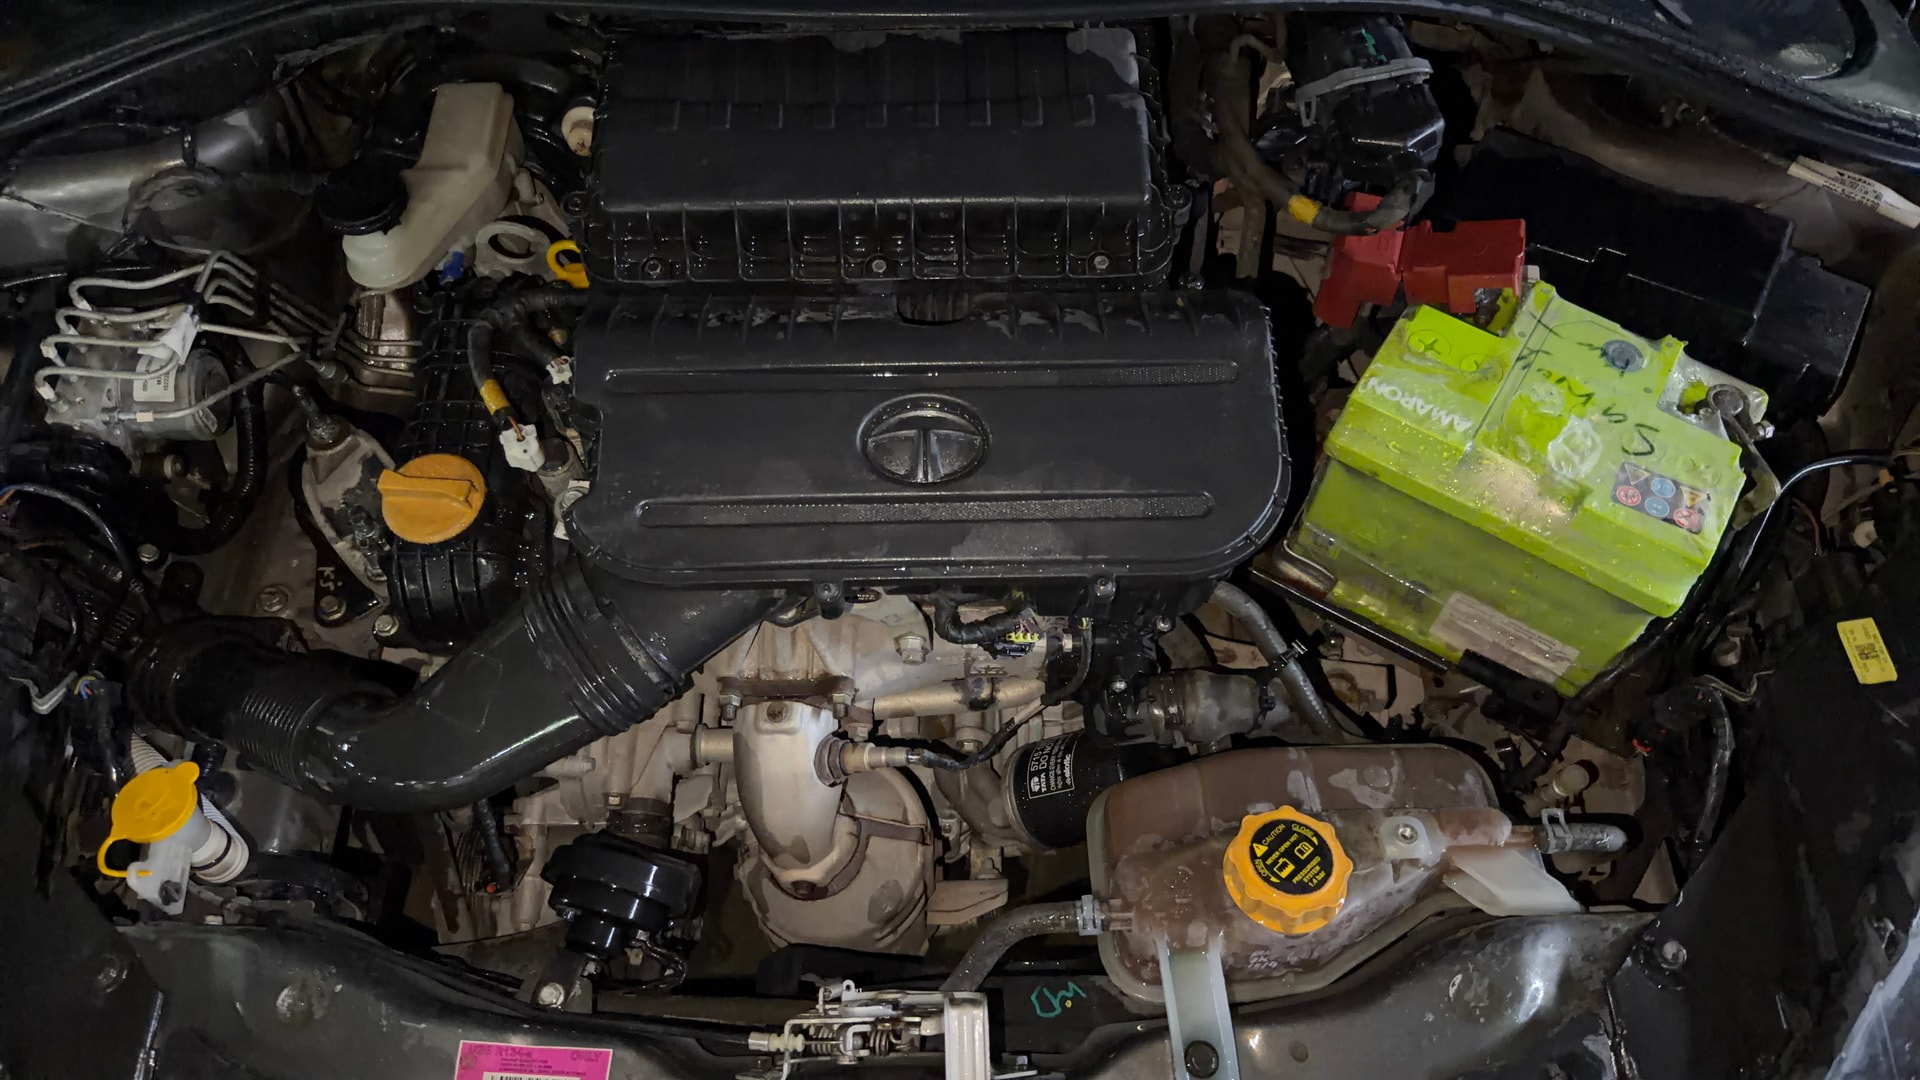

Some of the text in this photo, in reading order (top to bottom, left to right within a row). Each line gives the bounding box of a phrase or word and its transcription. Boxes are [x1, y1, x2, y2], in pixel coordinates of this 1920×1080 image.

[1366, 376, 1474, 433] AMARON
[1039, 755, 1049, 770] DO
[1262, 823, 1286, 845] CAUTION
[1291, 823, 1315, 837] CLOSE
[1279, 841, 1291, 853] OPEN
[1254, 859, 1268, 877] OPEN
